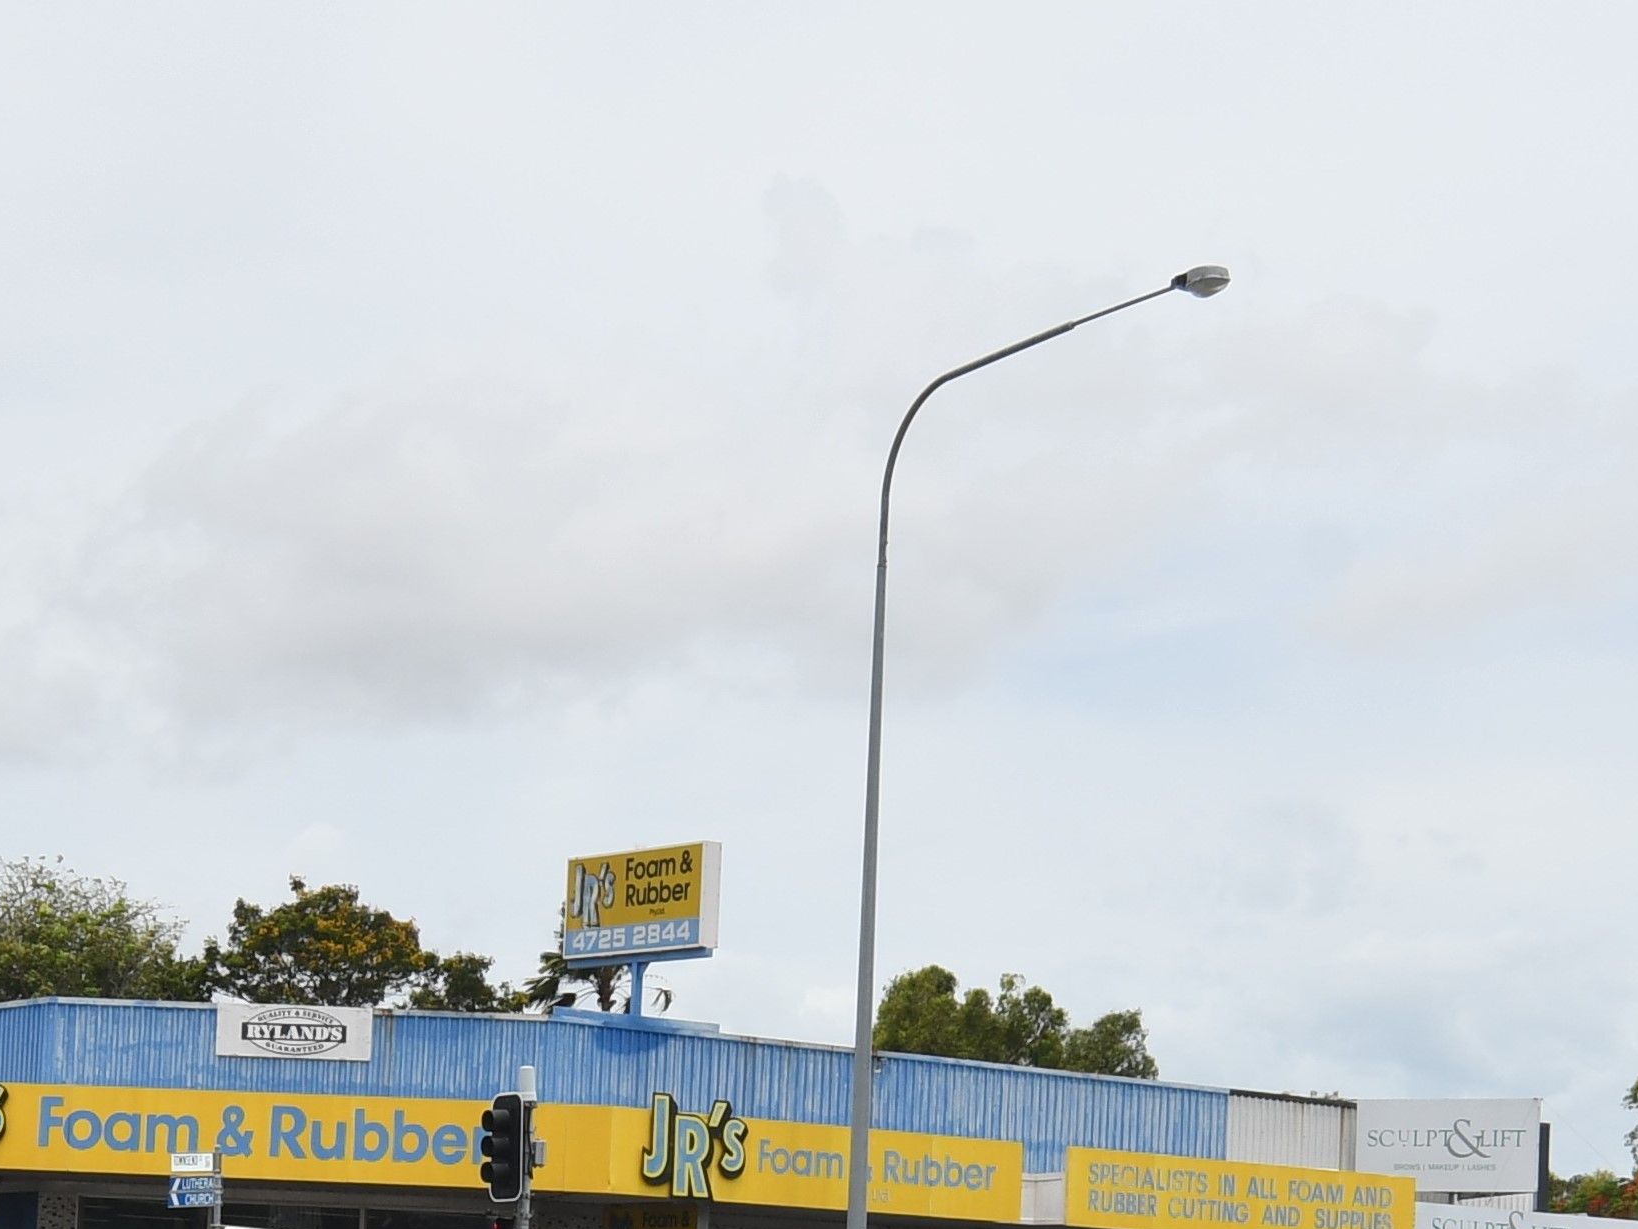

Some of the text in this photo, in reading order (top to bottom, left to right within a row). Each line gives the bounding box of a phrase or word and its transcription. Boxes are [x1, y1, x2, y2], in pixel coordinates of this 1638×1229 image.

[625, 850, 693, 881] Foam &
[625, 880, 690, 907] Rubber
[572, 919, 691, 951] 4725 2844
[265, 1042, 324, 1053] GUARANTEED
[38, 1096, 199, 1156] Foam
[216, 1104, 254, 1158] &
[642, 1092, 748, 1200] JR's
[758, 1137, 844, 1180] Foam
[883, 1149, 997, 1192] Rubber
[182, 1178, 215, 1190] LUTHERA
[184, 1193, 214, 1205] CHURCH
[1088, 1162, 1392, 1209] SPECIALISTS IN ALL FOAM AND
[1088, 1189, 1157, 1217] RUBBER
[1168, 1197, 1249, 1223] CUTTING
[1262, 1204, 1301, 1227] AND
